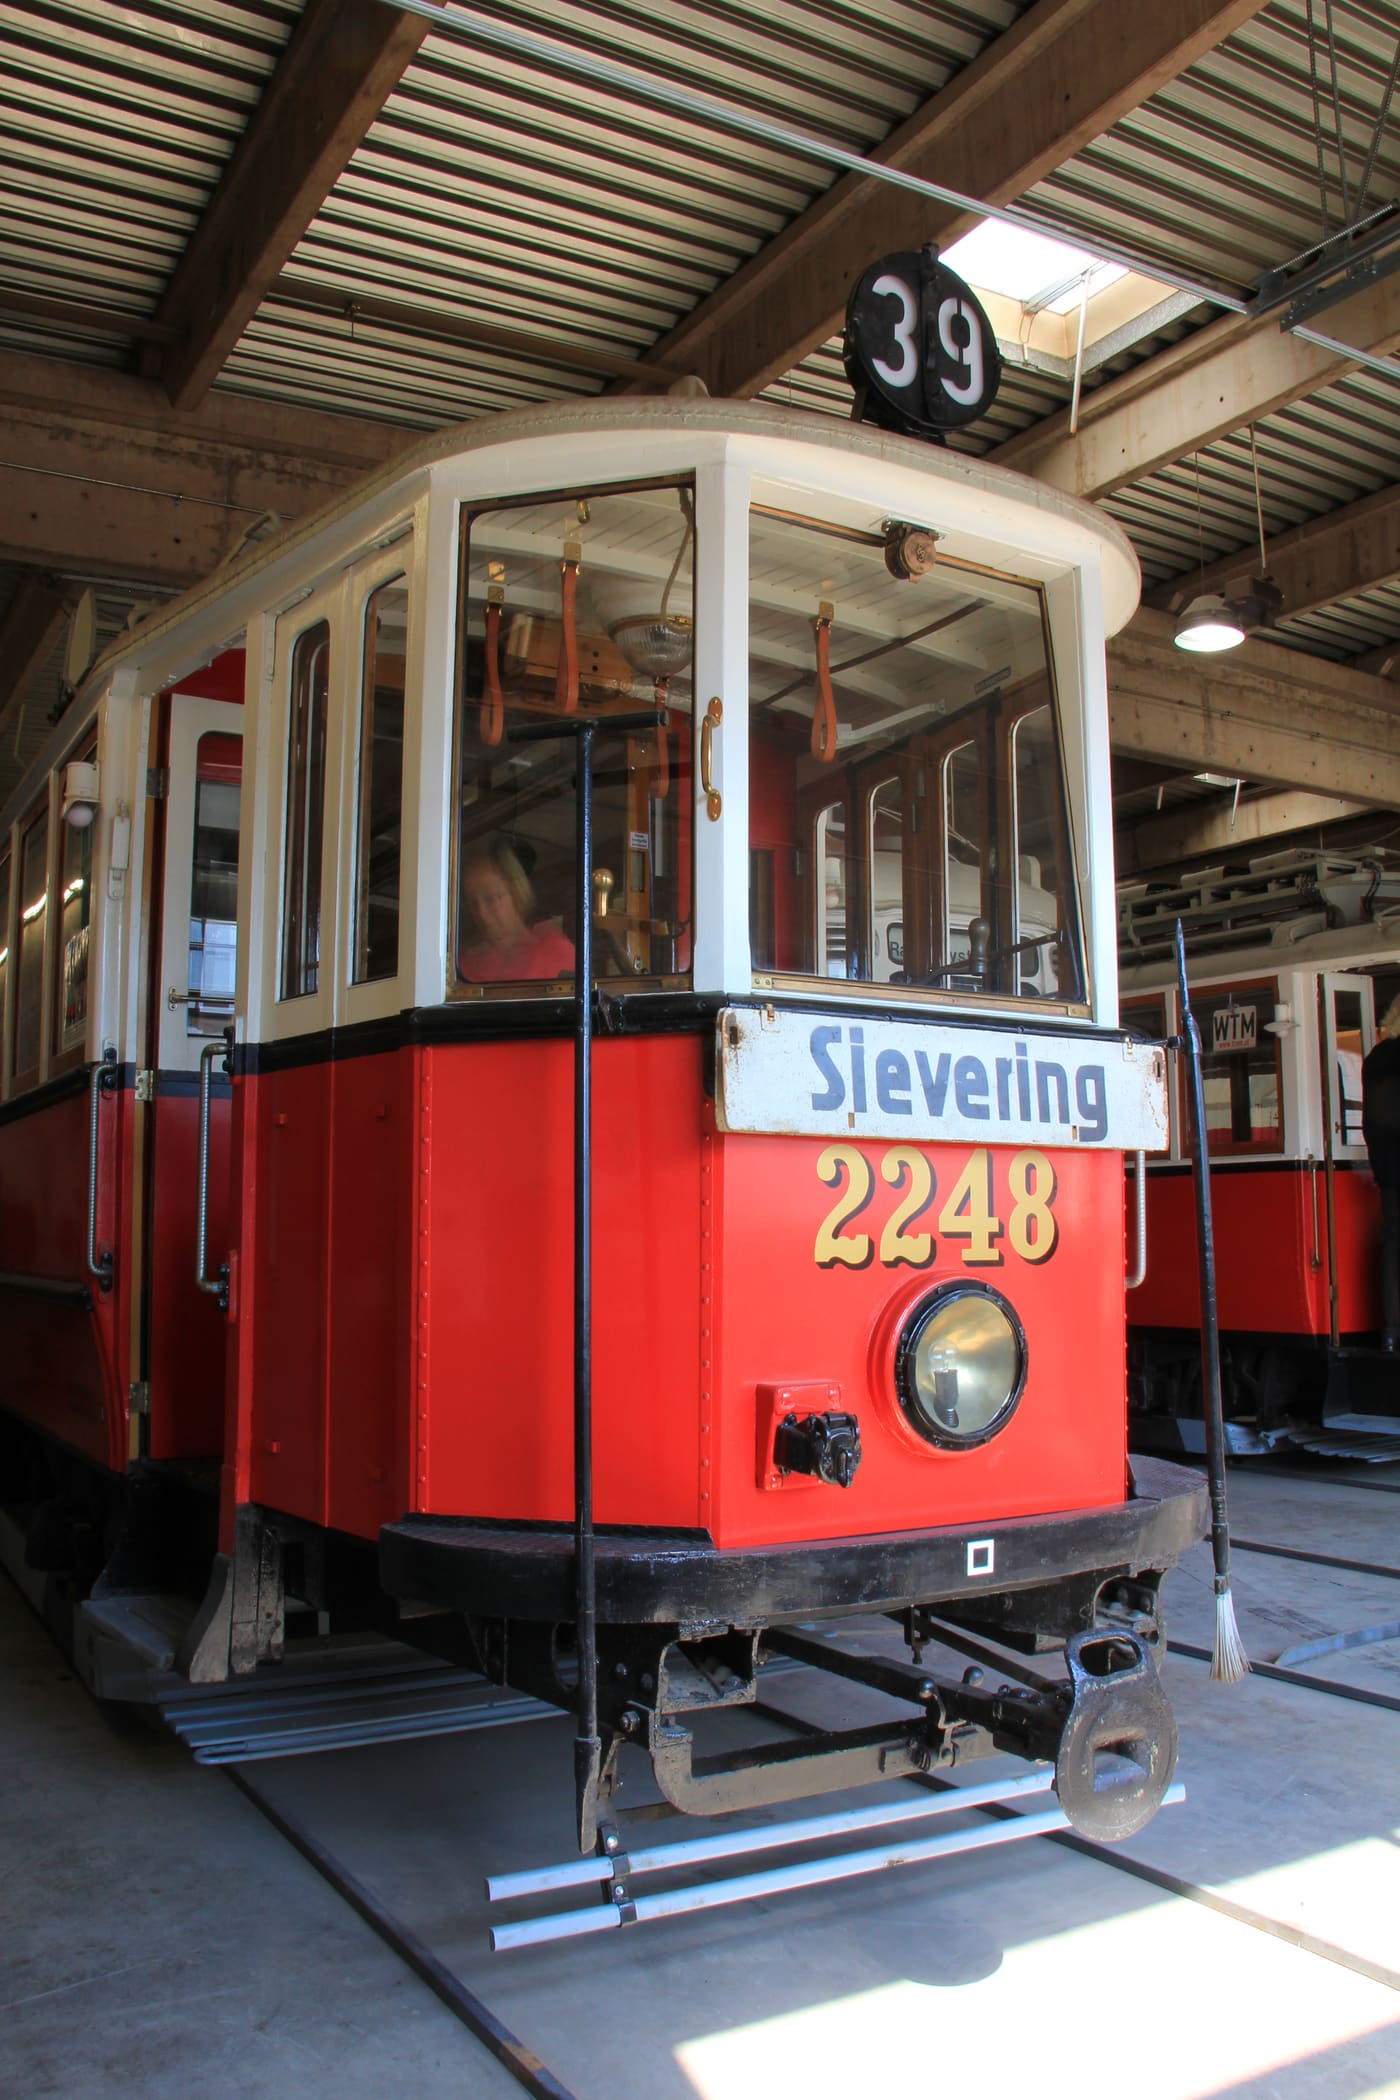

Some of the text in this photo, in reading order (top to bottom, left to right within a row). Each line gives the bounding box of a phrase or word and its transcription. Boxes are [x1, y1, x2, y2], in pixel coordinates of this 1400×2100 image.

[871, 274, 984, 406] 39
[809, 1025, 1109, 1142] Sievering
[1214, 1011, 1256, 1042] WTM
[814, 1143, 1059, 1270] 2248
